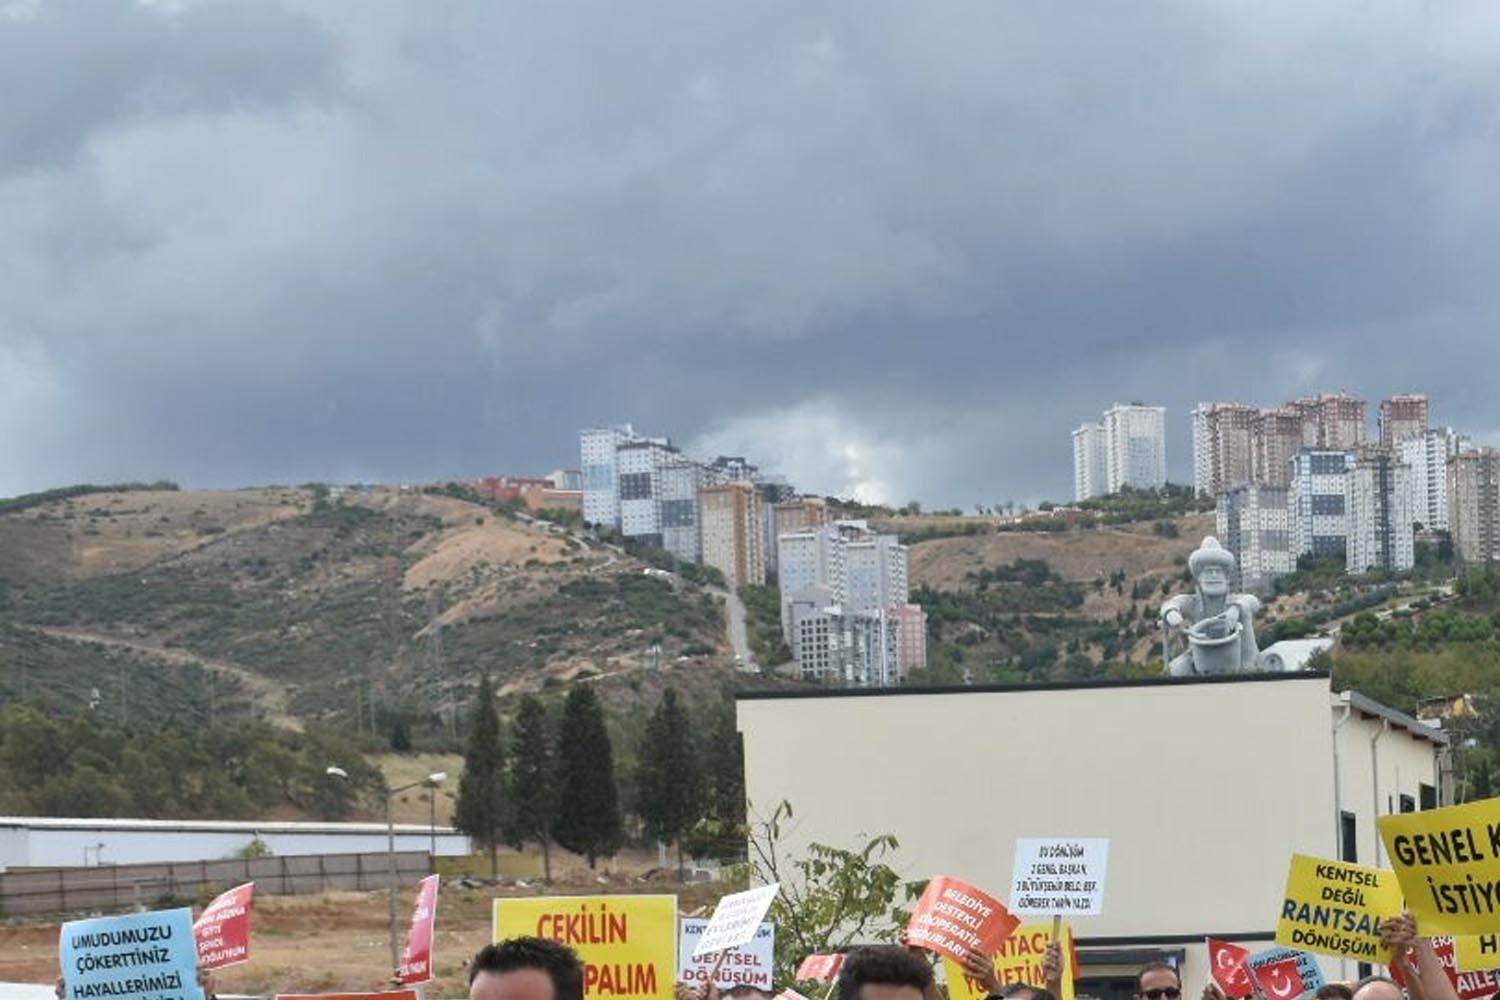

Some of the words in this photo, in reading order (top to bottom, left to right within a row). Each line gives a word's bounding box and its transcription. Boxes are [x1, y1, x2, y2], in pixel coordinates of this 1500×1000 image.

[1393, 827, 1484, 867] GENEL
[1316, 864, 1380, 888] KENTSEL
[1321, 886, 1366, 907] DEĞİL
[1282, 898, 1383, 937] RANTSAL
[72, 925, 172, 949] UMUDUMUZU
[1292, 929, 1377, 957] DÖNÜŞÜM
[76, 945, 171, 975] ÇÖKERTTİNİZ
[73, 971, 182, 999] HAYALLERİMİZİ
[585, 963, 657, 996] PALIM
[684, 966, 767, 985] DÖÜŞÜM
